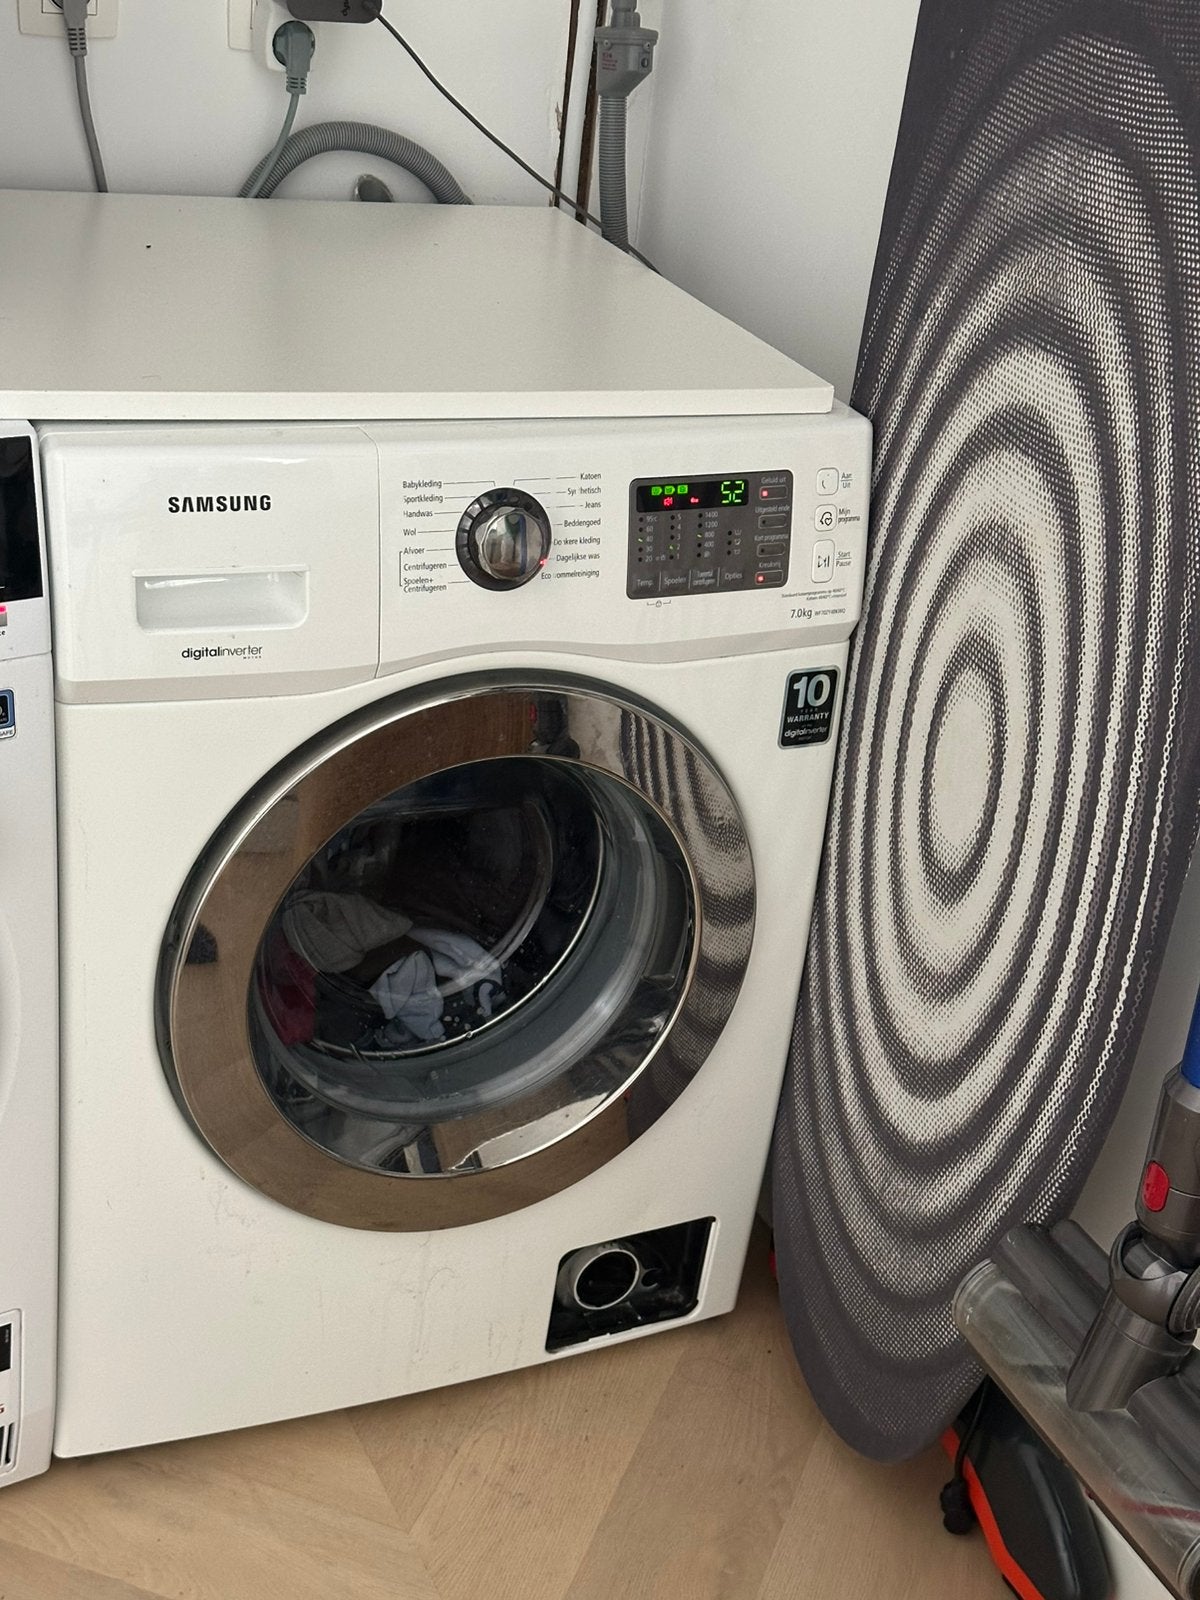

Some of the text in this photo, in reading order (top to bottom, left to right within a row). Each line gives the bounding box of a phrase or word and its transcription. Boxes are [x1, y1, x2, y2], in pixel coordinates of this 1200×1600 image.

[580, 472, 602, 480] Katoen
[402, 479, 442, 490] Babykleding
[721, 480, 744, 504] 52
[168, 494, 272, 514] SAMSUNG
[584, 501, 602, 509] Jeans
[564, 518, 602, 528] Beddengoed
[402, 528, 417, 537] Wol
[579, 536, 601, 546] kleding
[402, 546, 426, 555] Afvoer
[838, 551, 851, 559] Start
[556, 552, 601, 563] Dagelijkse was
[403, 561, 448, 572] Centrifugeren
[541, 571, 552, 580] Eco
[403, 584, 448, 594] Centrifugeren
[790, 608, 813, 620] 7.0kg
[793, 674, 831, 709] 10
[786, 711, 830, 724] WARRANTY
